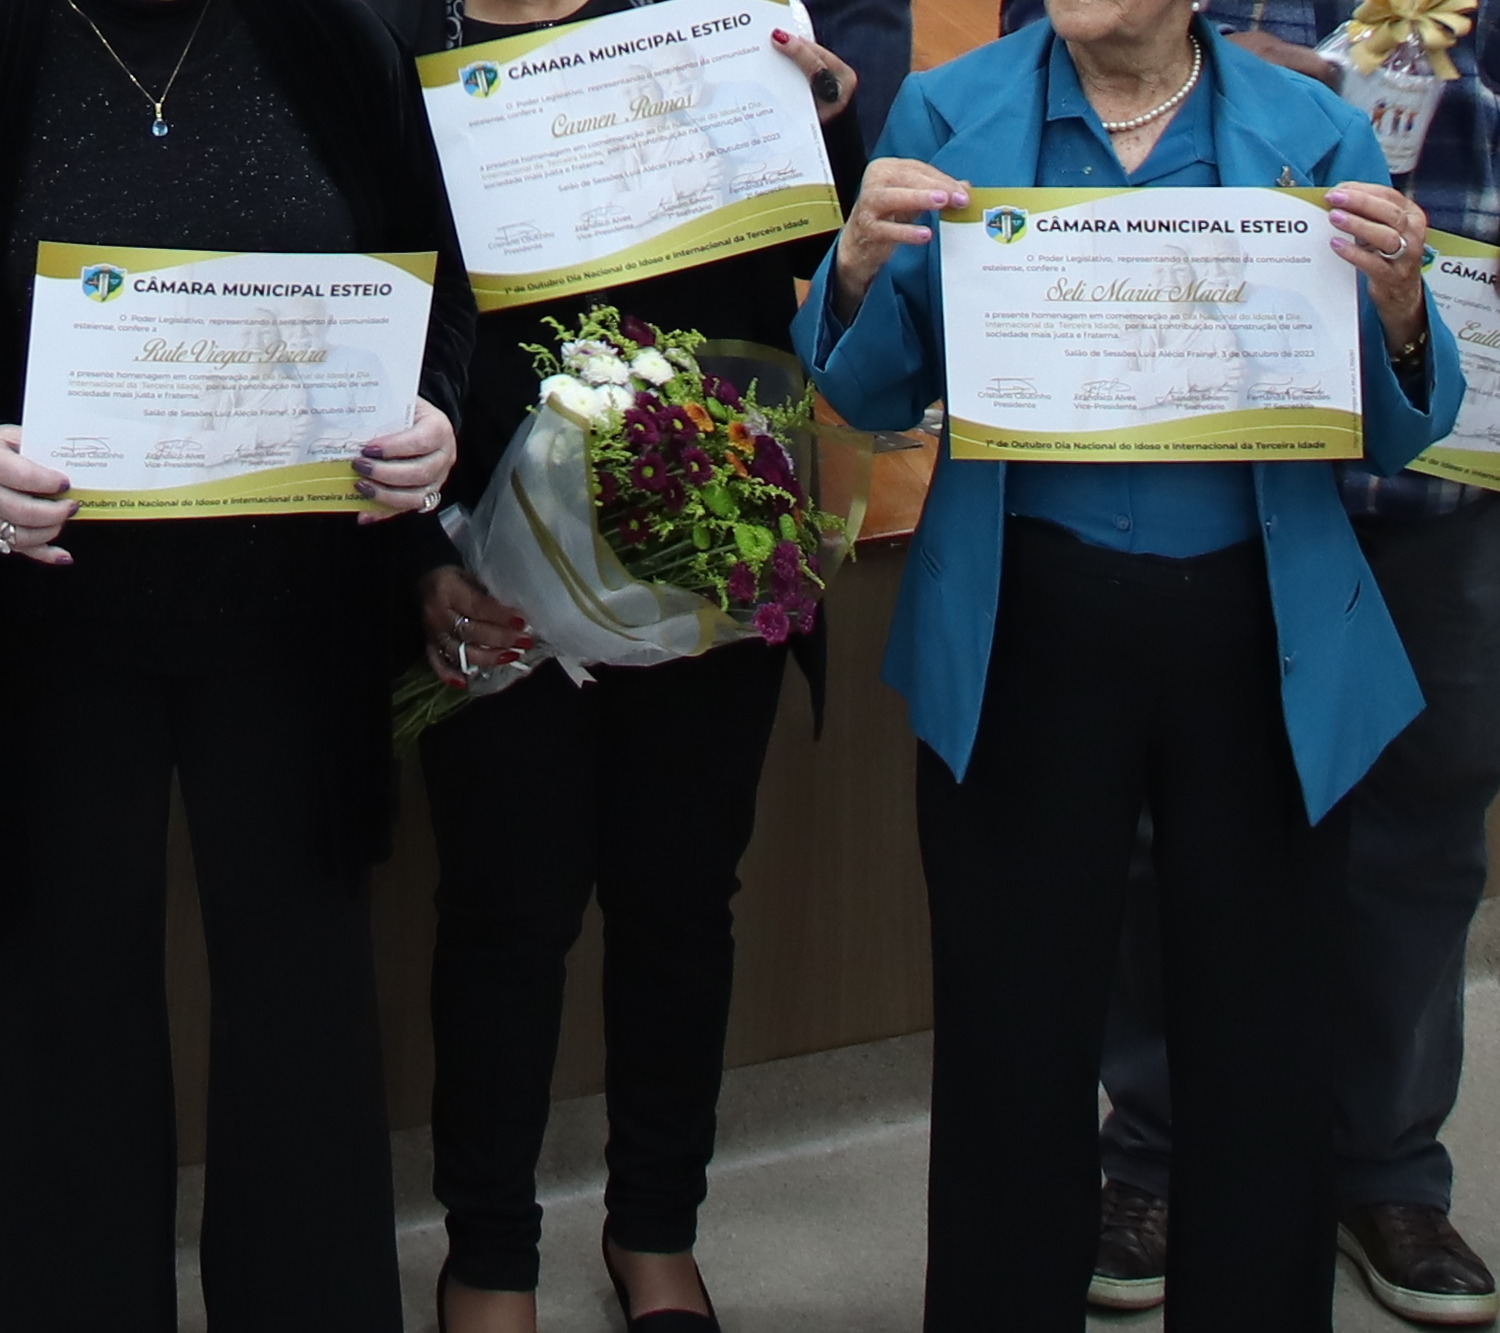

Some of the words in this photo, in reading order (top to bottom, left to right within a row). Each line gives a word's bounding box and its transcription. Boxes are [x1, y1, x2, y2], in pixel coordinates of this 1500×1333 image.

[507, 54, 586, 80] CÂMARA
[589, 29, 687, 64] MUNICIPAL
[691, 12, 752, 38] ESTEIO
[550, 112, 618, 139] Carmen
[625, 93, 692, 123] Ramos
[1036, 215, 1121, 234] CÂMARA
[1127, 220, 1234, 234] MUNICIPAL
[1241, 220, 1309, 234] ESTEIO
[1440, 261, 1498, 285] CÂMAR
[133, 276, 217, 295] CÂMARA
[222, 281, 325, 297] MUNICIPAL
[330, 283, 393, 297] ESTEIO
[1046, 277, 1087, 303] Seli
[1091, 277, 1164, 303] Maria
[1167, 278, 1248, 304] Maciel
[996, 440, 1009, 448] de
[1011, 440, 1053, 450] Outubro
[1055, 441, 1071, 450] Dia
[1073, 442, 1117, 451] Nacional
[1119, 442, 1132, 451] do
[1135, 442, 1161, 451] Idoso
[1172, 442, 1239, 451] Internacional
[1241, 442, 1253, 450] da
[1255, 442, 1296, 450] Terceira
[1298, 441, 1326, 450] Idade
